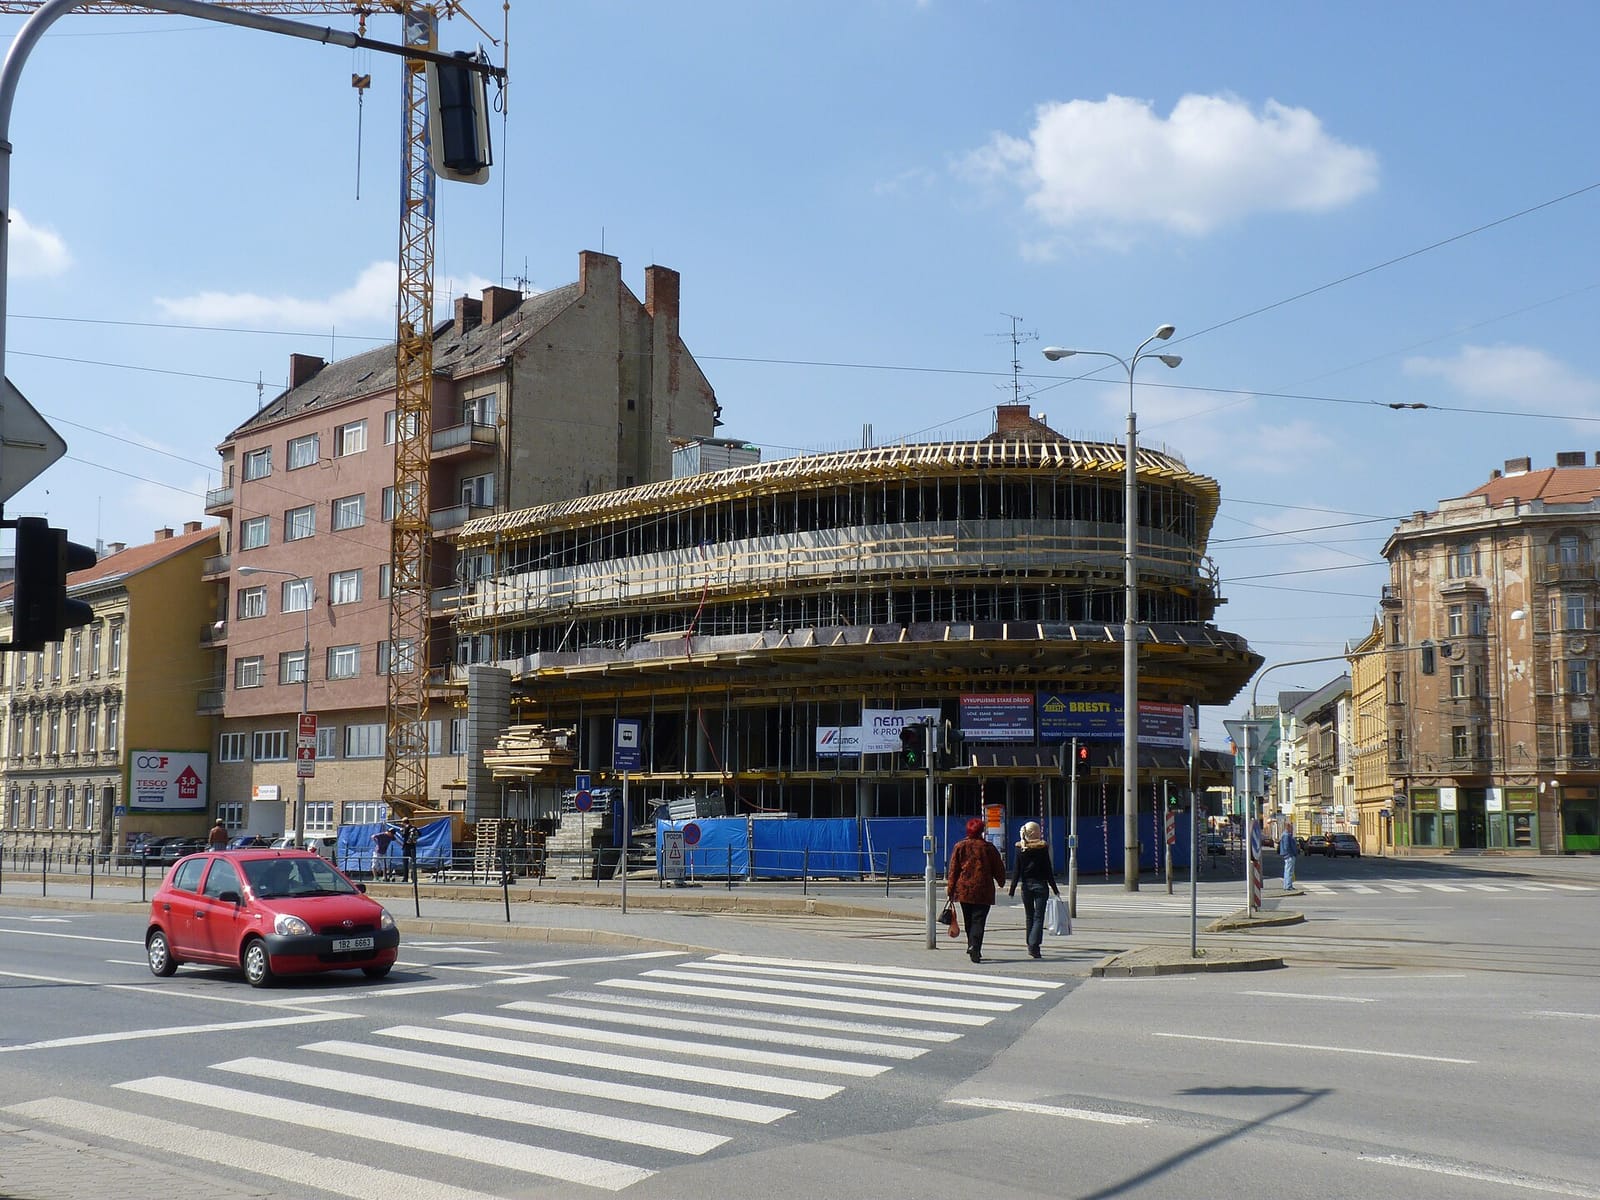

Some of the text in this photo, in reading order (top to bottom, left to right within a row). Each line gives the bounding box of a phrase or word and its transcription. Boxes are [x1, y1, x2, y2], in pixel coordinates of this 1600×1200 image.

[832, 737, 859, 745] CEMEX
[137, 756, 168, 769] OCF
[181, 776, 196, 786] 3,8
[181, 786, 195, 794] km
